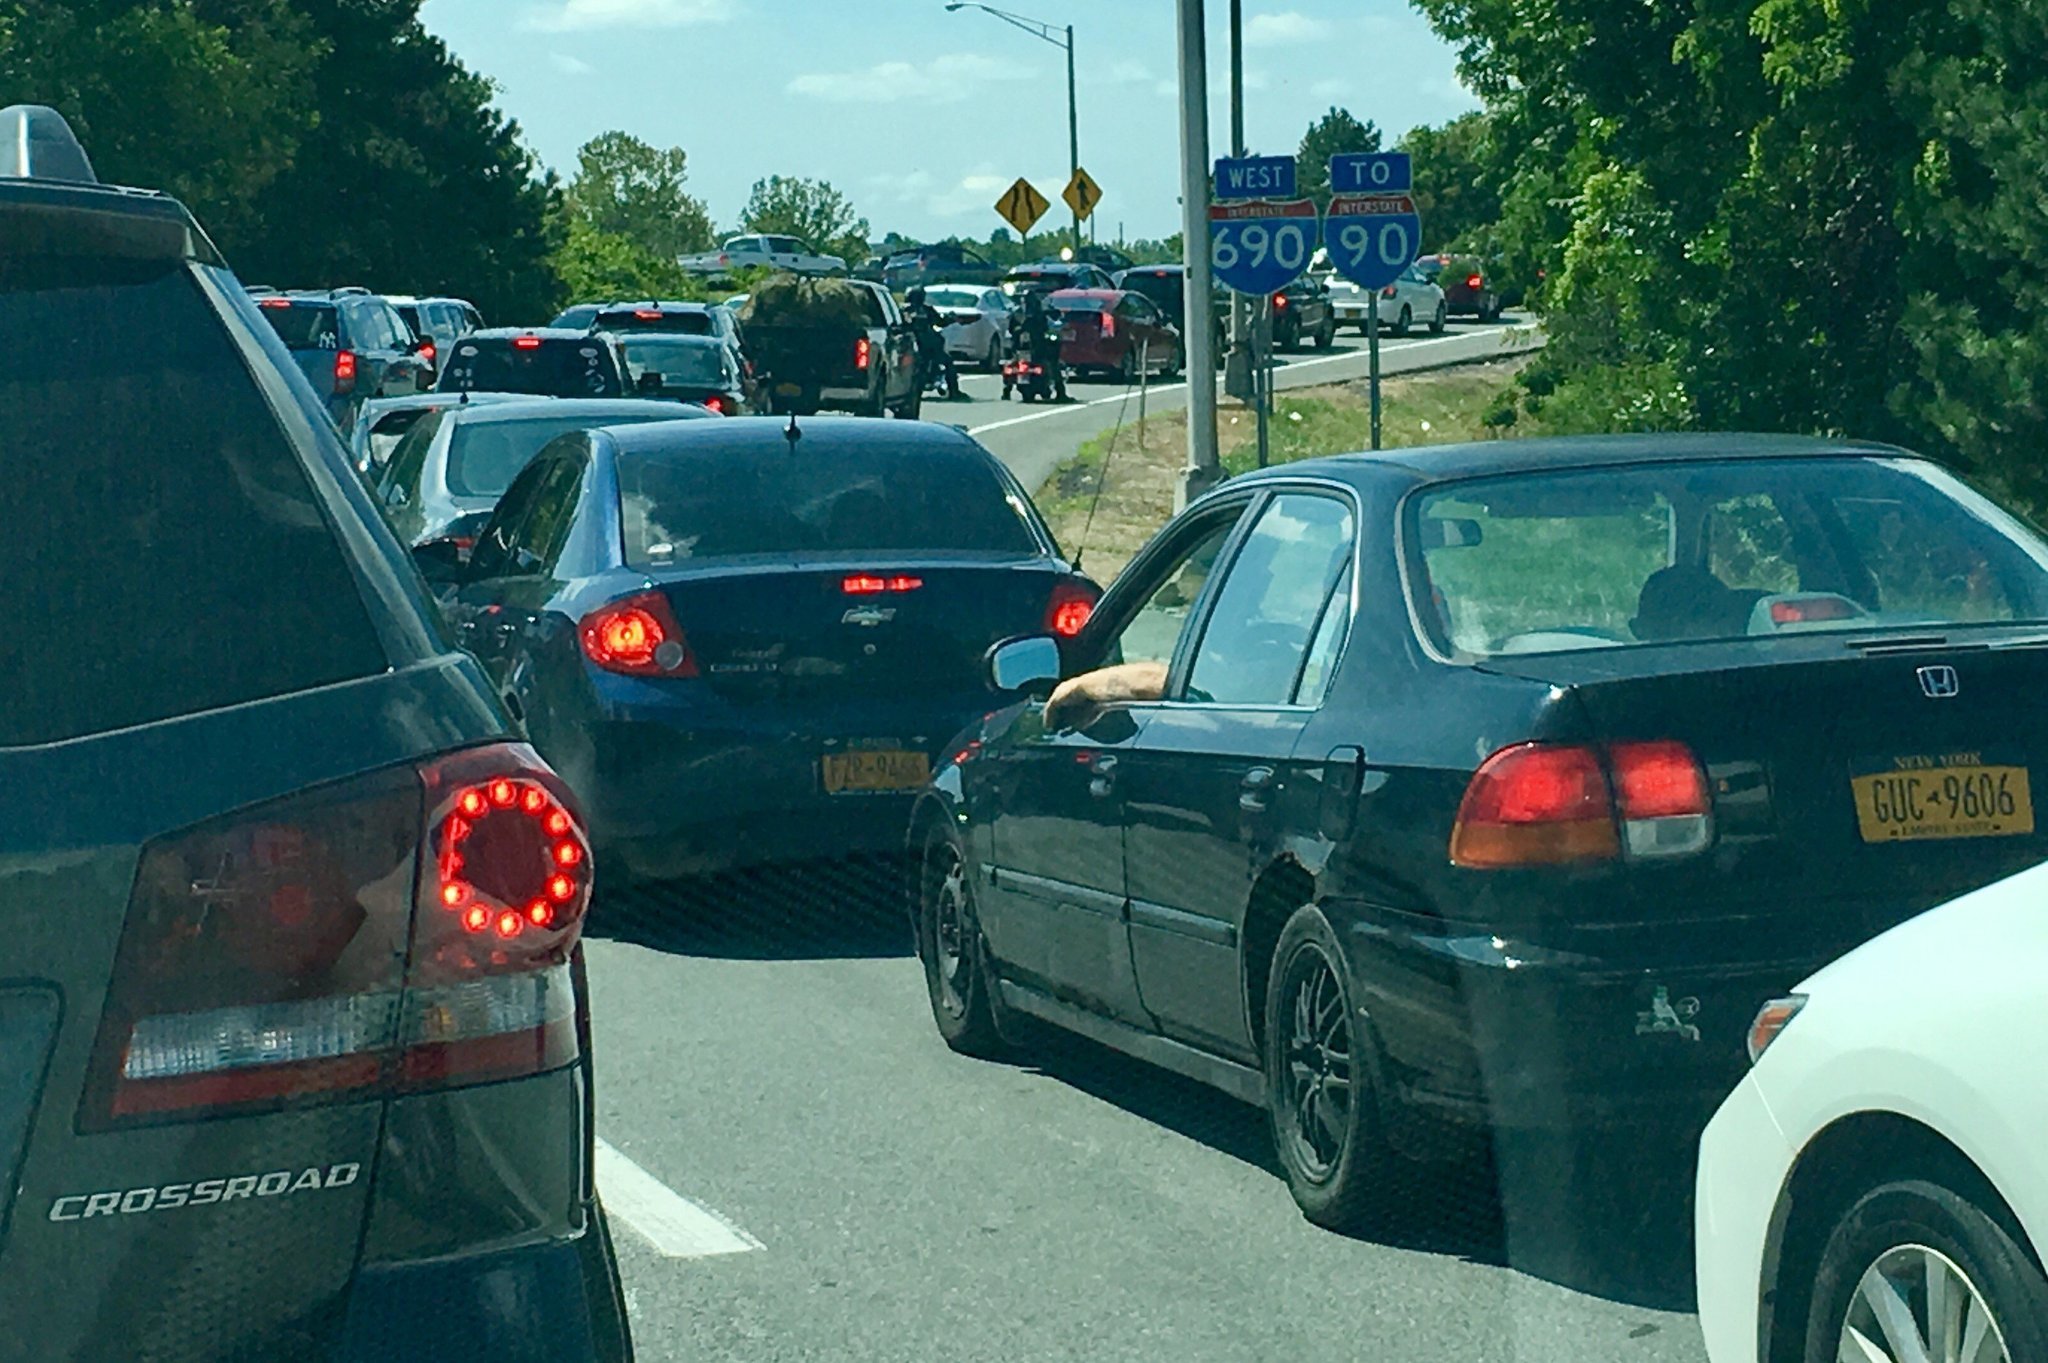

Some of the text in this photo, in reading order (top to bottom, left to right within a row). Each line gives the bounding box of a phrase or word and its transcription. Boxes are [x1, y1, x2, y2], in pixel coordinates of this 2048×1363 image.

[1229, 166, 1283, 189] WEST
[1350, 161, 1390, 185] TO
[1227, 205, 1285, 218] INTERSTATE
[1339, 200, 1404, 215] INTERSTATE
[1211, 224, 1305, 270] 690
[1340, 222, 1408, 267] 90
[49, 1162, 360, 1222] CROSSROAD
